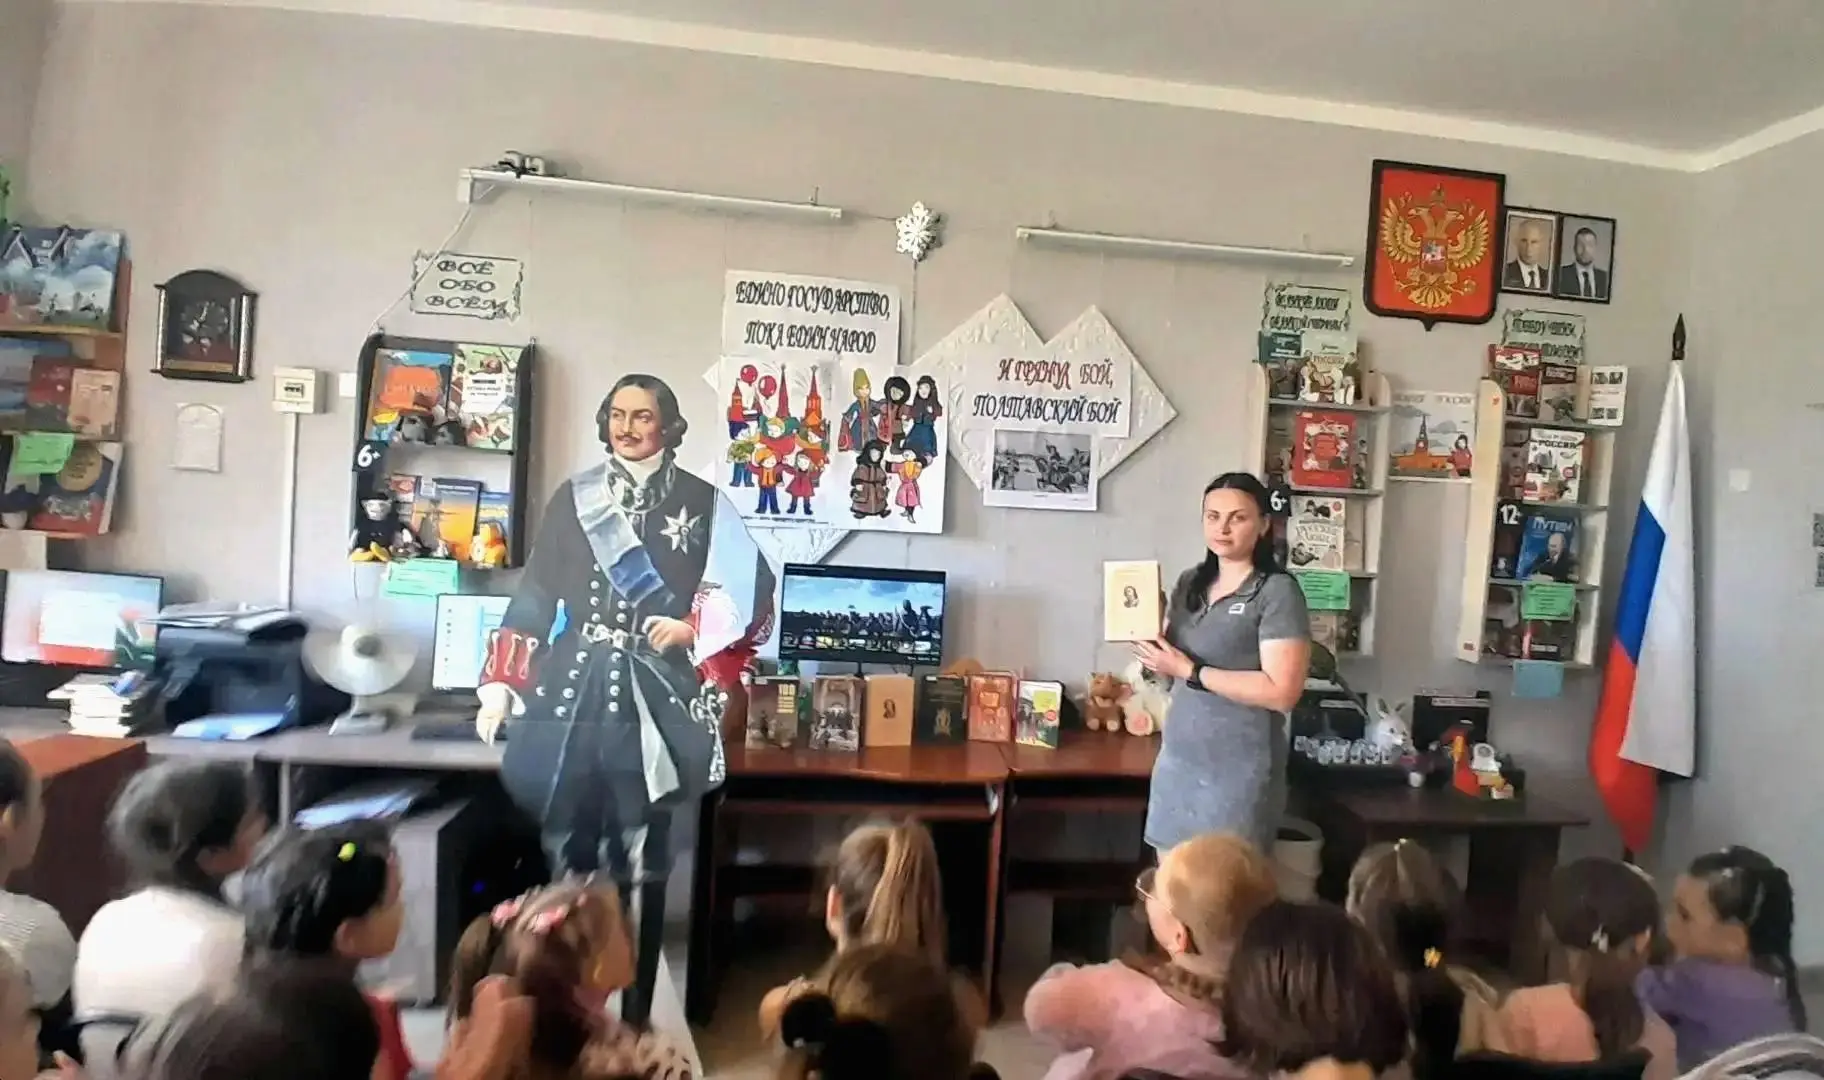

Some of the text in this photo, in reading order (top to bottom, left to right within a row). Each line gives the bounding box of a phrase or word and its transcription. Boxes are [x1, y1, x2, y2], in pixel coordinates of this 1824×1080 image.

[439, 278, 496, 293] ОБО
[735, 280, 890, 321] ЕДИНО ГОСУДАРСТВО,
[744, 320, 877, 354] ПОКА ЕДИН НАРОД
[997, 358, 1113, 390] И ГРЯНУЛ БОЙ,
[972, 393, 1122, 424] ПОЛТАВСКИЙ БОЙ
[1270, 490, 1288, 511] 6+
[1500, 504, 1522, 525] 12+
